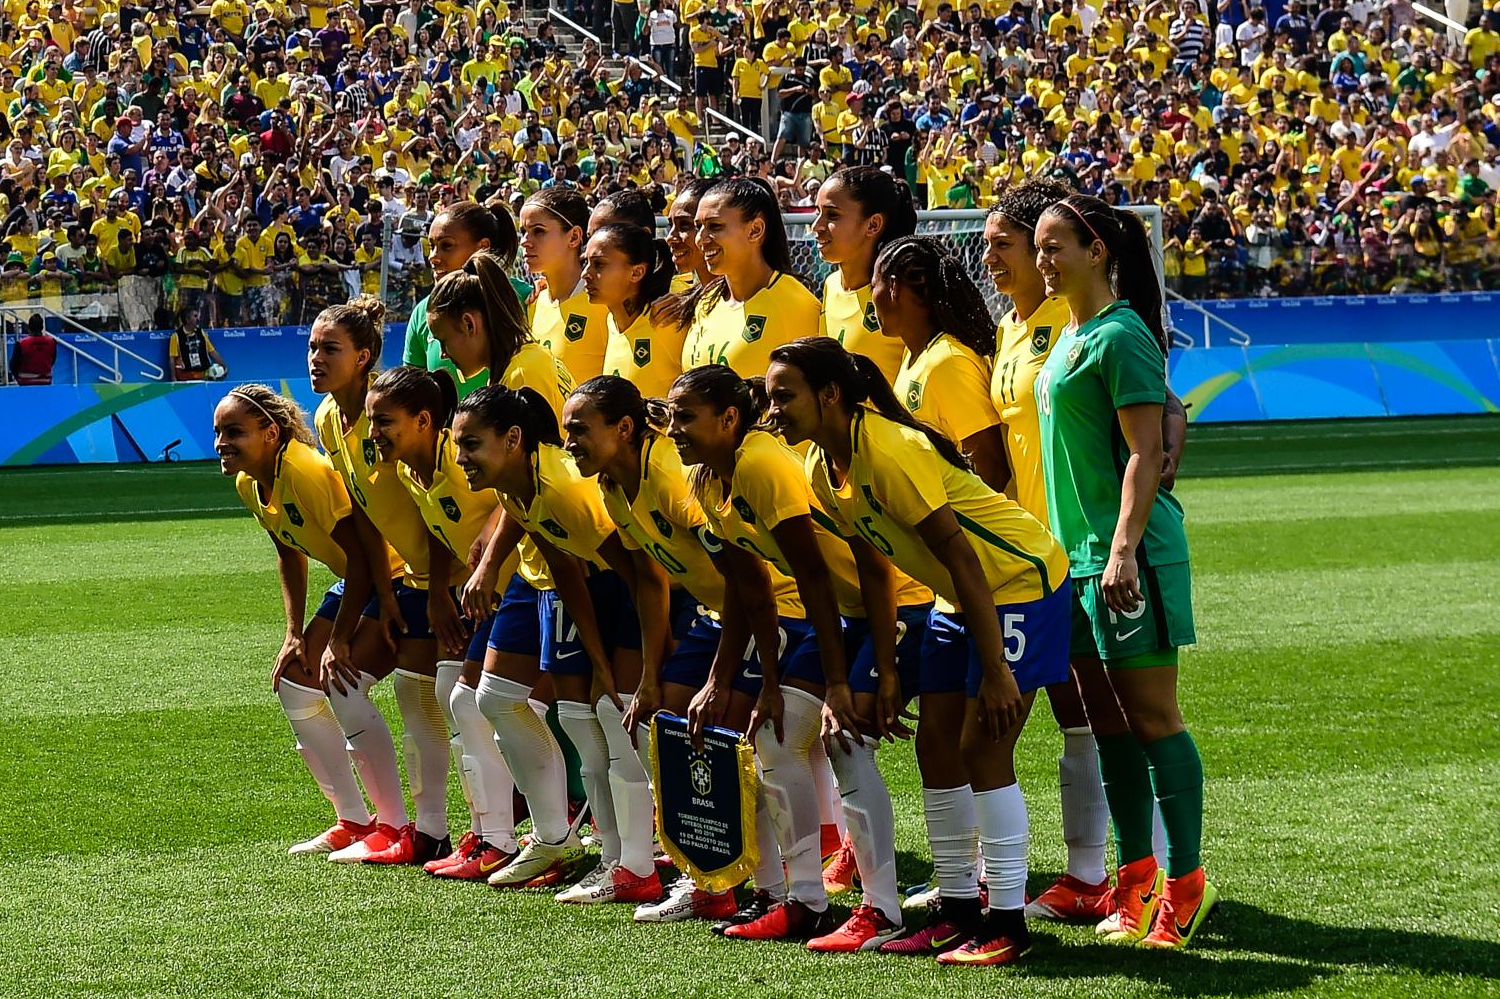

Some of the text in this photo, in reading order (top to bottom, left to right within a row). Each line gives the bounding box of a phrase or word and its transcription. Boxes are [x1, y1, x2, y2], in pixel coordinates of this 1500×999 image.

[692, 797, 715, 809] BRASIL
[691, 841, 708, 849] PAULO
[712, 846, 731, 855] BRASIL
